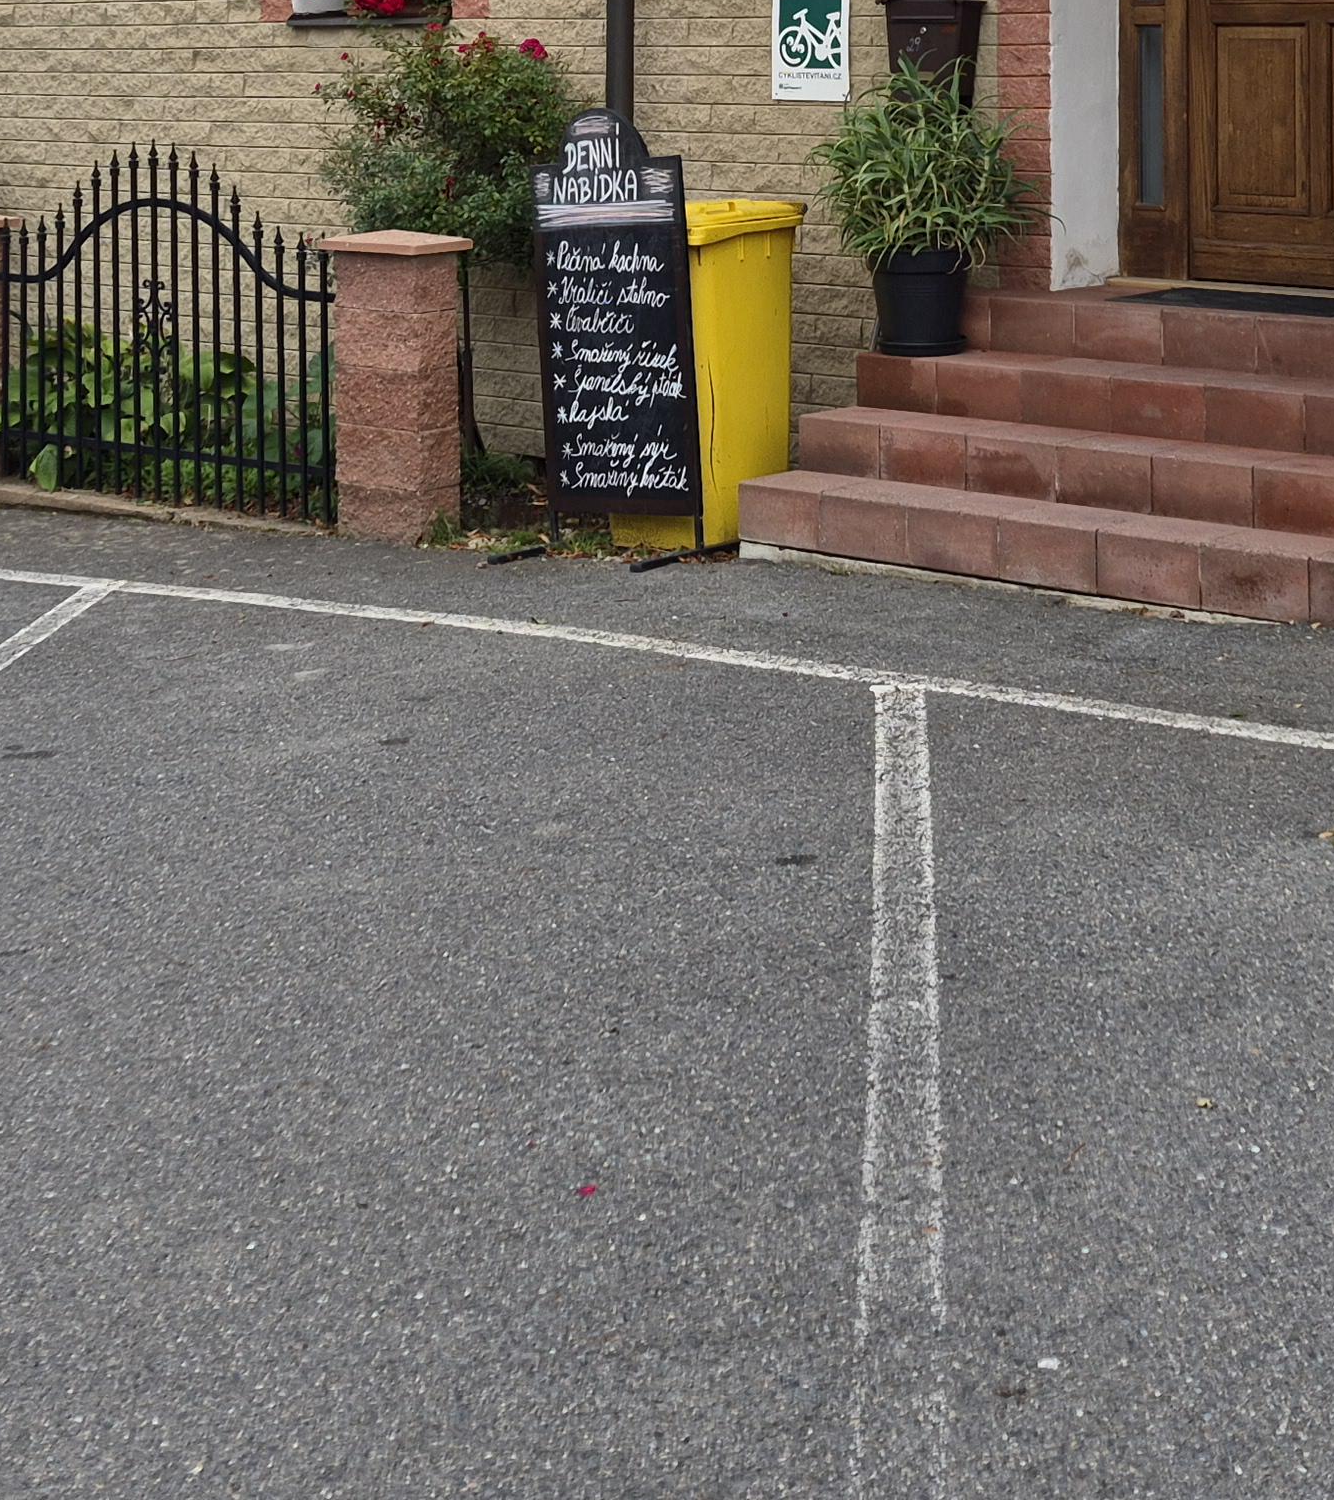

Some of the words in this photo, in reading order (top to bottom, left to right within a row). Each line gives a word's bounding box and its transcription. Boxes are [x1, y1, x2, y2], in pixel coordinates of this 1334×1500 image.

[563, 122, 620, 174] DENNÍ
[553, 168, 638, 204] NABÍDKA
[608, 240, 664, 274] kachna
[617, 276, 670, 308] stehno
